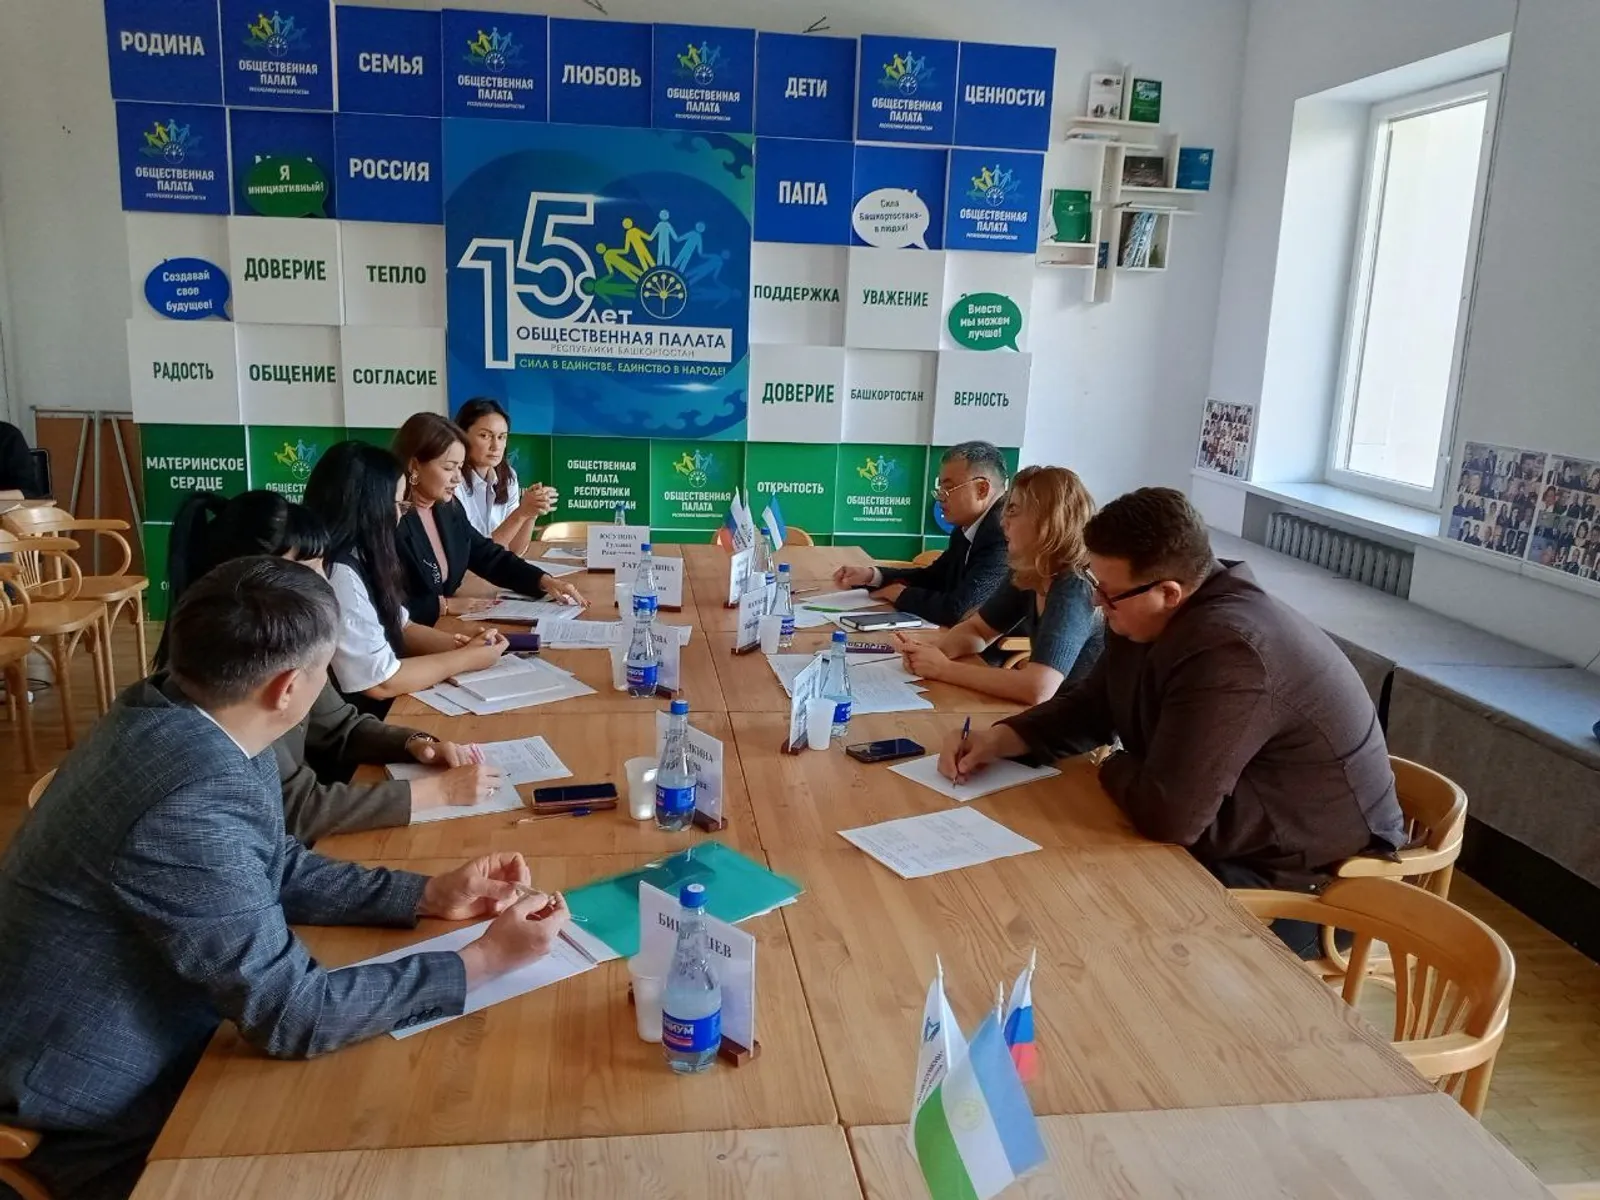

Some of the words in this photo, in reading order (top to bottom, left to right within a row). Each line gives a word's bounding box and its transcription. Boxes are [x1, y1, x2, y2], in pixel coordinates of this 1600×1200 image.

[120, 31, 205, 56] РОДИНА
[239, 59, 318, 75] ОБЩЕСТВЕННАЯ
[358, 52, 424, 75] СЕМЬЯ
[260, 73, 297, 87] ПАЛАТА
[458, 75, 533, 90] ОБЩЕСТВЕННАЯ
[562, 64, 642, 88] ЛЮБОВЬ
[478, 88, 513, 102] ПАЛАТА
[667, 87, 740, 103] ОБЩЕСТВЕННАЯ
[785, 76, 828, 99] ДЕТИ
[872, 97, 942, 112] ОБЩЕСТВЕННАЯ
[965, 85, 1046, 108] ЦЕННОСТИ
[686, 101, 720, 114] ПАЛАТА
[890, 111, 923, 123] ПАЛАТА
[135, 166, 214, 181] ОБЩЕСТВЕННАЯ
[280, 165, 290, 181] Я
[349, 157, 430, 182] РОССИЯ
[157, 180, 194, 192] ПАЛАТА
[779, 181, 828, 206] ПАПА
[960, 208, 1028, 223] ОБЩЕСТВЕННАЯ
[976, 220, 1008, 233] ПАЛАТА
[162, 270, 210, 283] Создавай
[244, 257, 327, 282] ДОВЕРИЕ
[366, 264, 427, 284] ТЕПЛО
[754, 285, 840, 303] ПОДДЕРЖКА
[863, 289, 929, 307] УВАЖЕНИЕ
[516, 326, 653, 346] ОБЩЕСТВЕННАЯ
[659, 332, 726, 349] ПАЛАТА
[550, 343, 613, 355] РЕСПУБЛИКИ
[618, 346, 695, 358] БАШКОРТОСТАН
[153, 362, 214, 382] РАДОСТЬ
[249, 364, 337, 384] ОБЩЕНИЕ
[519, 359, 549, 370] СИЛА
[552, 360, 559, 370] В
[617, 362, 671, 374] ЕДИНСТВО
[673, 364, 680, 374] В
[682, 365, 726, 376] НАРОДЕ!
[352, 368, 438, 386] СОГЛАСИЕ
[762, 382, 835, 405] ДОВЕРИЕ
[850, 388, 924, 402] БАШКОРТОСТАН
[954, 391, 1010, 408] ВЕРНОСТЬ
[146, 456, 245, 472] МАТЕРИНСКОЕ
[567, 460, 636, 472] ОБЩЕСТВЕННАЯ
[170, 476, 223, 492] СЕРДЦЕ
[585, 473, 619, 484] ПАЛАТА
[265, 482, 307, 494] ОБЩЕСТ
[574, 486, 630, 498] РЕСПУБЛИКИ
[757, 481, 824, 495] ОТКРЫТОСТЬ
[664, 491, 731, 502] ОБЩЕСТВЕННАЯ
[846, 495, 911, 507] ОБЩЕСТВЕННАЯ
[681, 501, 713, 512] ПАЛАТА
[863, 506, 893, 516] ПАЛАТА
